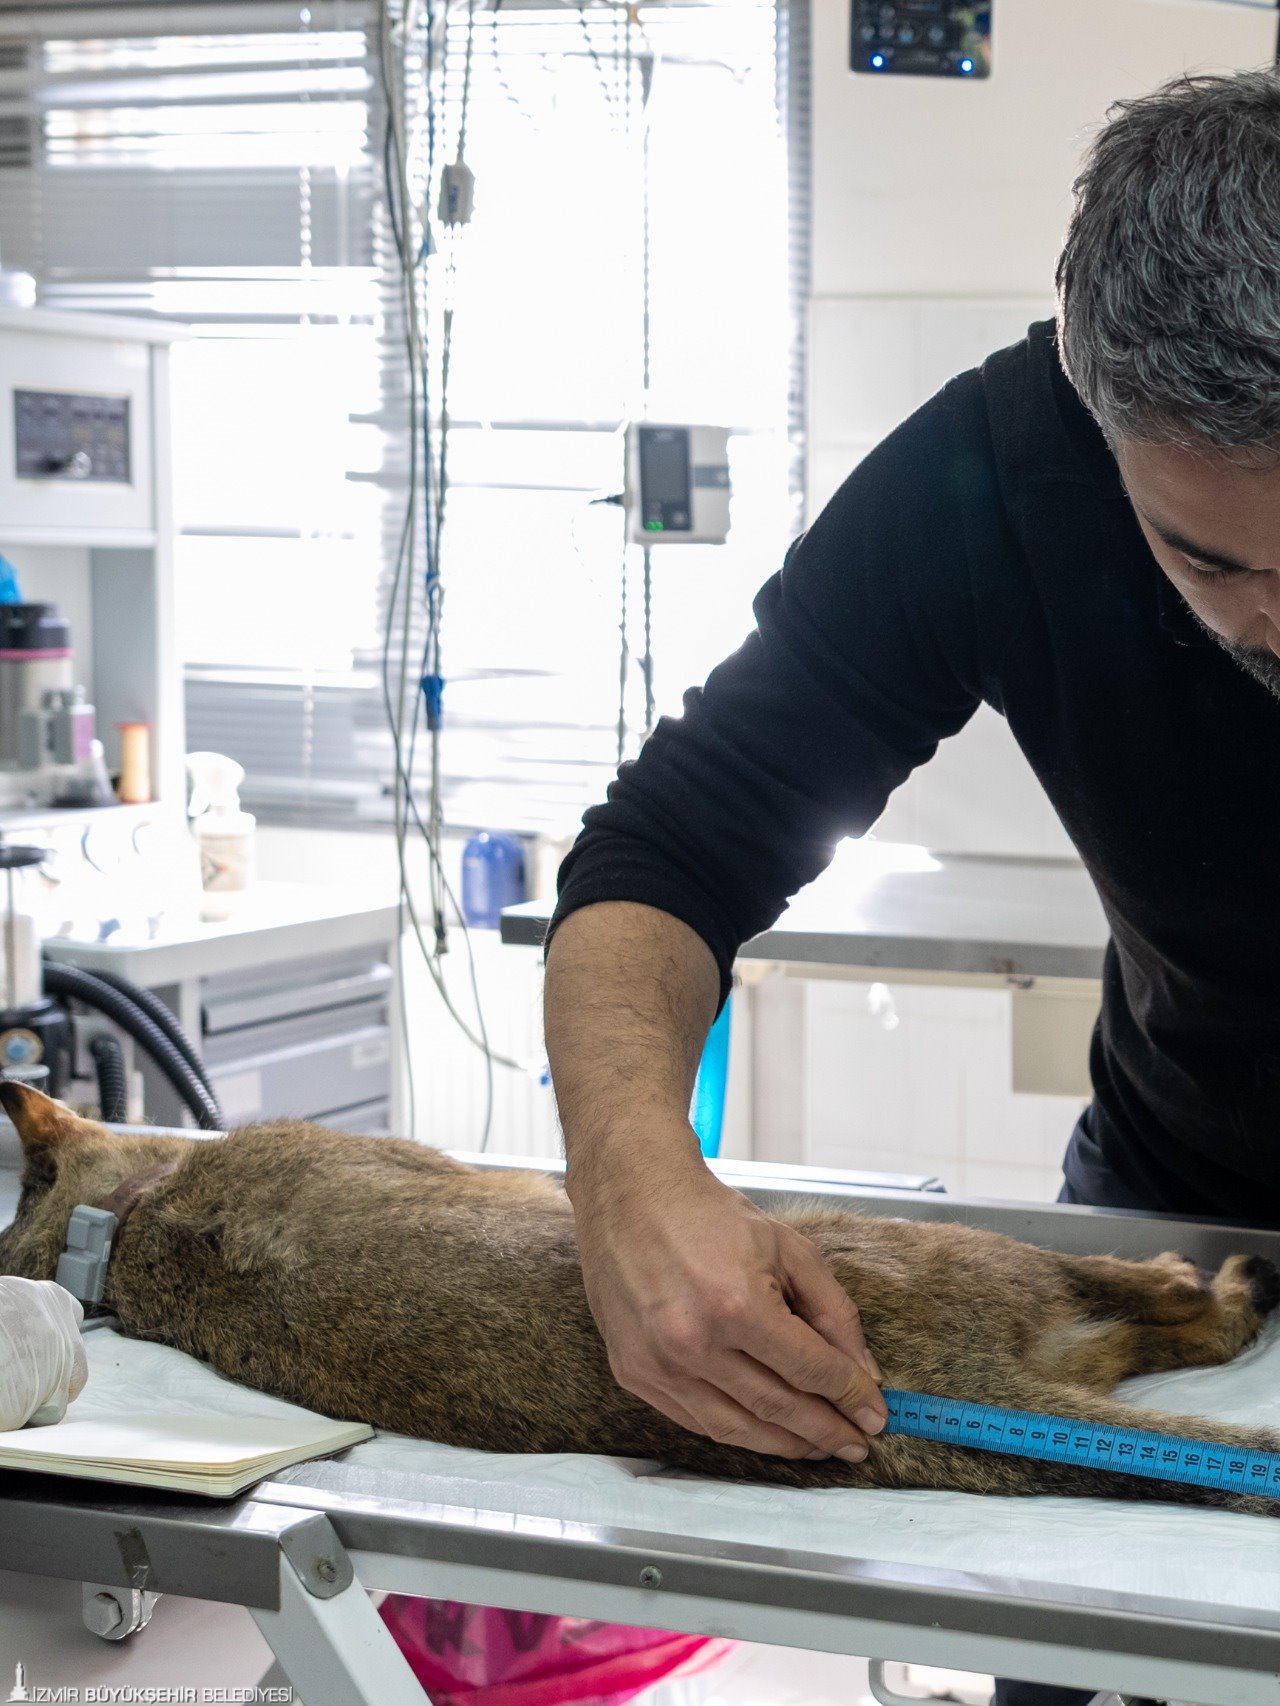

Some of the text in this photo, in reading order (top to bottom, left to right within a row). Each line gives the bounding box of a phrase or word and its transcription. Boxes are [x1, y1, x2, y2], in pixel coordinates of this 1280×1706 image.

[905, 1411, 918, 1420] 3
[925, 1414, 938, 1424] 4
[945, 1417, 959, 1426] 5
[966, 1420, 981, 1429] 6
[987, 1423, 1002, 1433] 7
[1009, 1427, 1024, 1437] 8
[1031, 1431, 1046, 1440] 9
[1052, 1432, 1068, 1446] 10
[1074, 1435, 1090, 1449] 11
[1096, 1438, 1112, 1453] 12
[1117, 1442, 1134, 1457] 13
[1140, 1446, 1156, 1460] 14
[1162, 1449, 1178, 1463] 15
[1184, 1453, 1200, 1467] 16
[1206, 1456, 1222, 1471] 17
[1228, 1460, 1245, 1475] 18
[1251, 1464, 1267, 1478] 19
